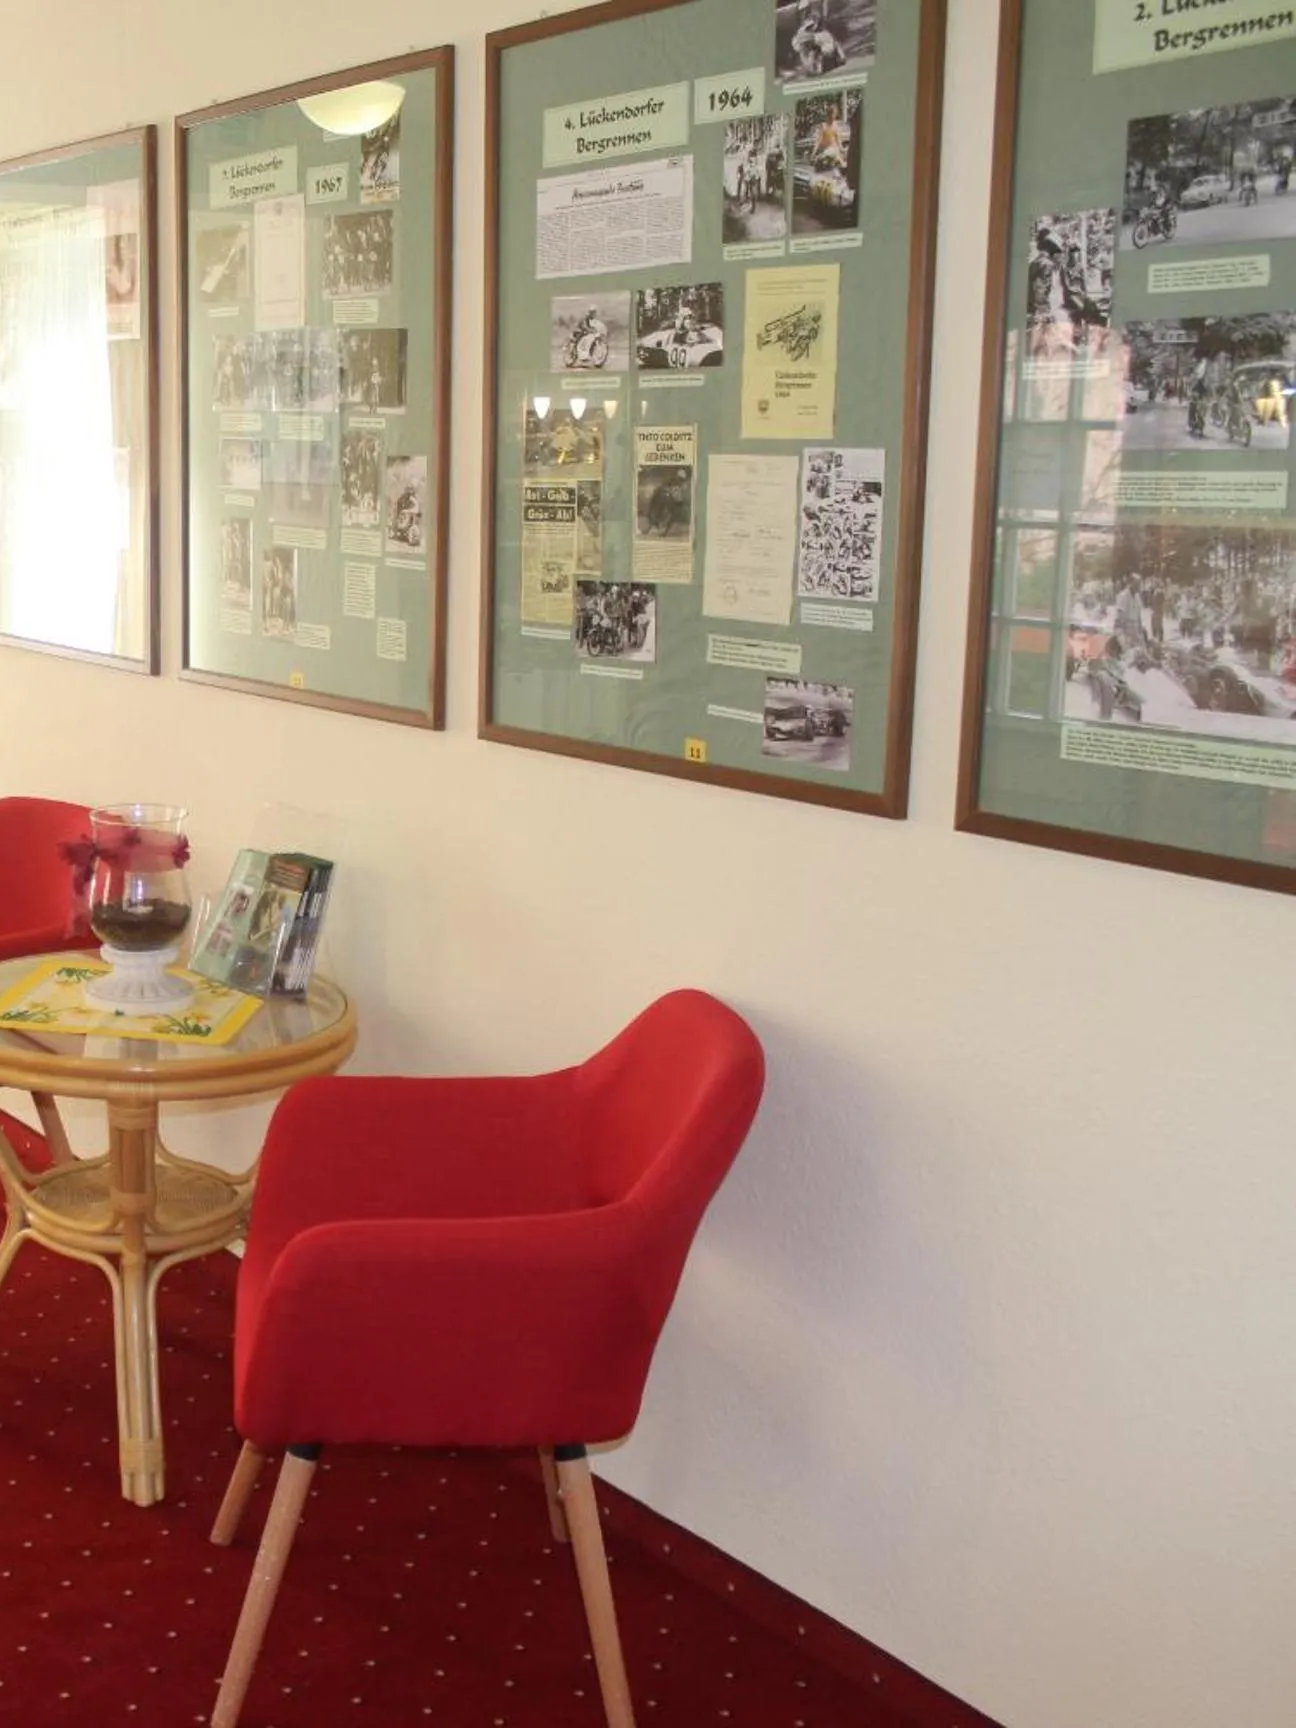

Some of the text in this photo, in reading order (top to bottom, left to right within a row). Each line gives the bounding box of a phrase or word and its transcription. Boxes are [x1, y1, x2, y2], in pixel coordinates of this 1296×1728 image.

[1134, 3, 1152, 21] 2.
[1154, 10, 1294, 51] Bergrennen
[708, 86, 753, 111] 1964
[564, 97, 665, 130] 4. Lückendorfer
[576, 130, 652, 153] Bergrennen
[315, 177, 343, 194] 1967
